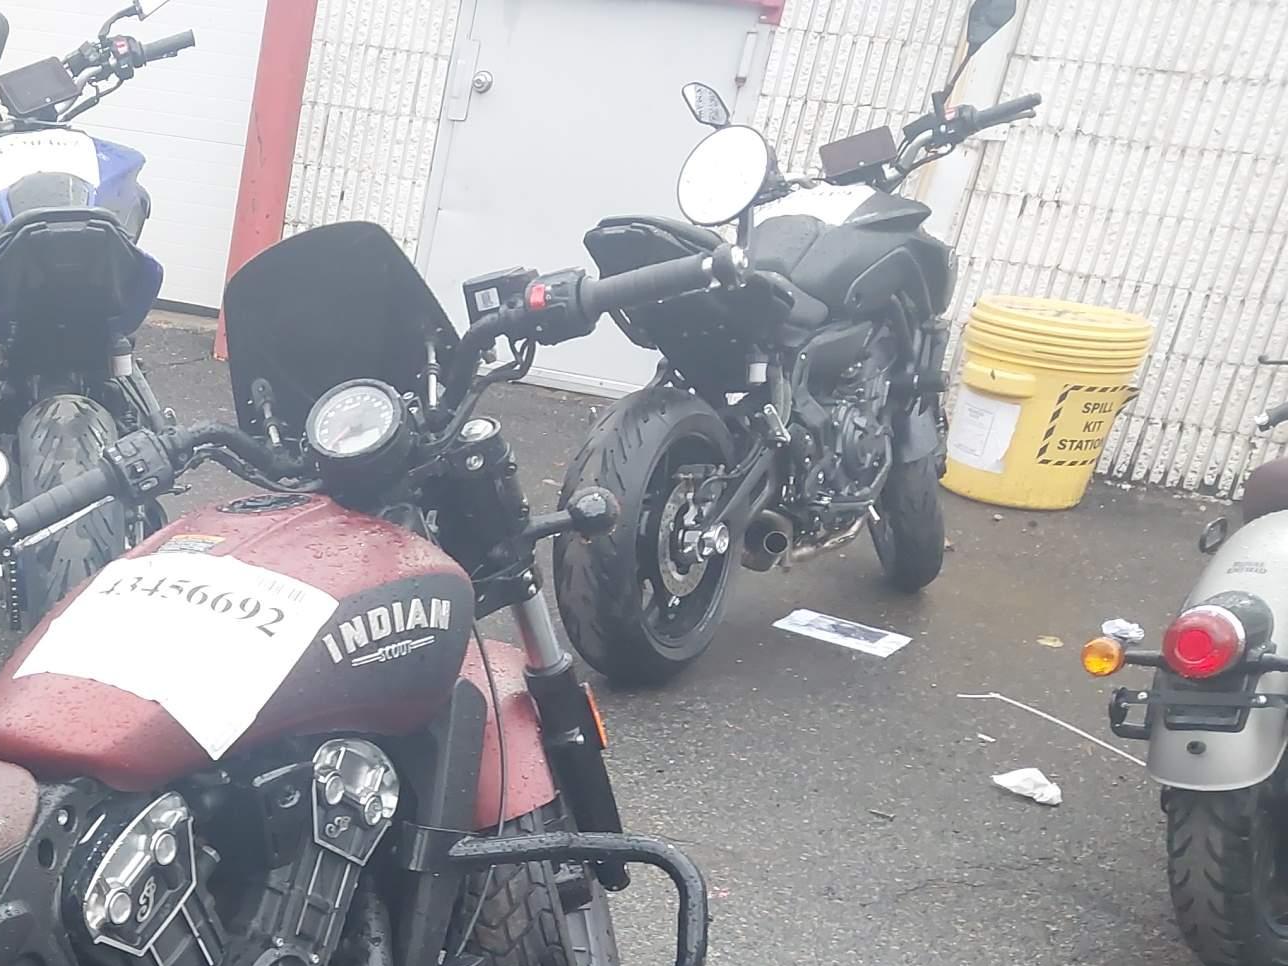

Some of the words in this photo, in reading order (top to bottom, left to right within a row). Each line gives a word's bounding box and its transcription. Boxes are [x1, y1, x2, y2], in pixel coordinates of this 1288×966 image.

[1081, 402, 1114, 414] SPILL
[1082, 420, 1105, 433] KIT
[1056, 438, 1104, 451] STATIO
[321, 598, 452, 664] INDIAN
[377, 640, 413, 662] SCOUT
